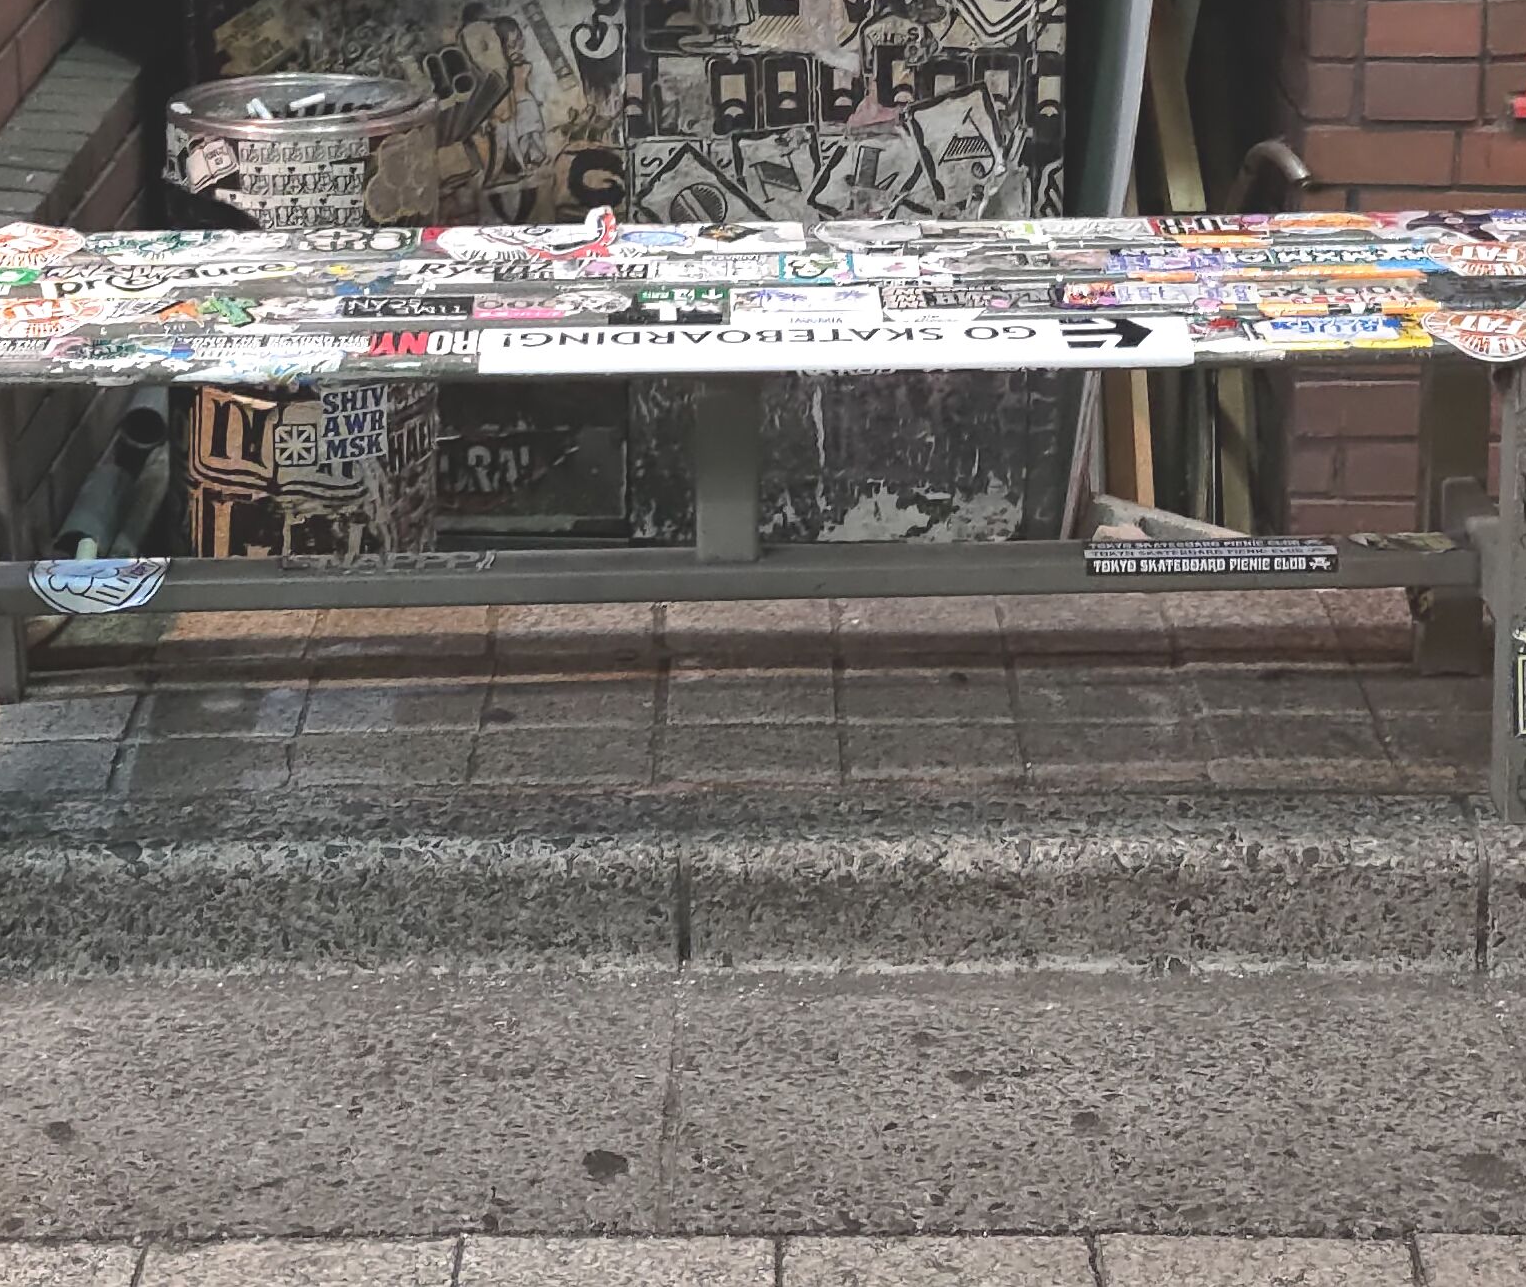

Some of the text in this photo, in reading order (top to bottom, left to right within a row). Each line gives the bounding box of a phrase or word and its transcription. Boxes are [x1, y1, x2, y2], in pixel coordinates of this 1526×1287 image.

[502, 325, 1037, 349] GO SKATEBOARDING!
[322, 384, 385, 415] SHIV
[323, 409, 385, 438] AWR
[326, 431, 383, 461] MSK
[1093, 558, 1137, 573] TOKYO
[1139, 558, 1226, 573] SKATEBOARD
[1229, 557, 1270, 572] PICNIC
